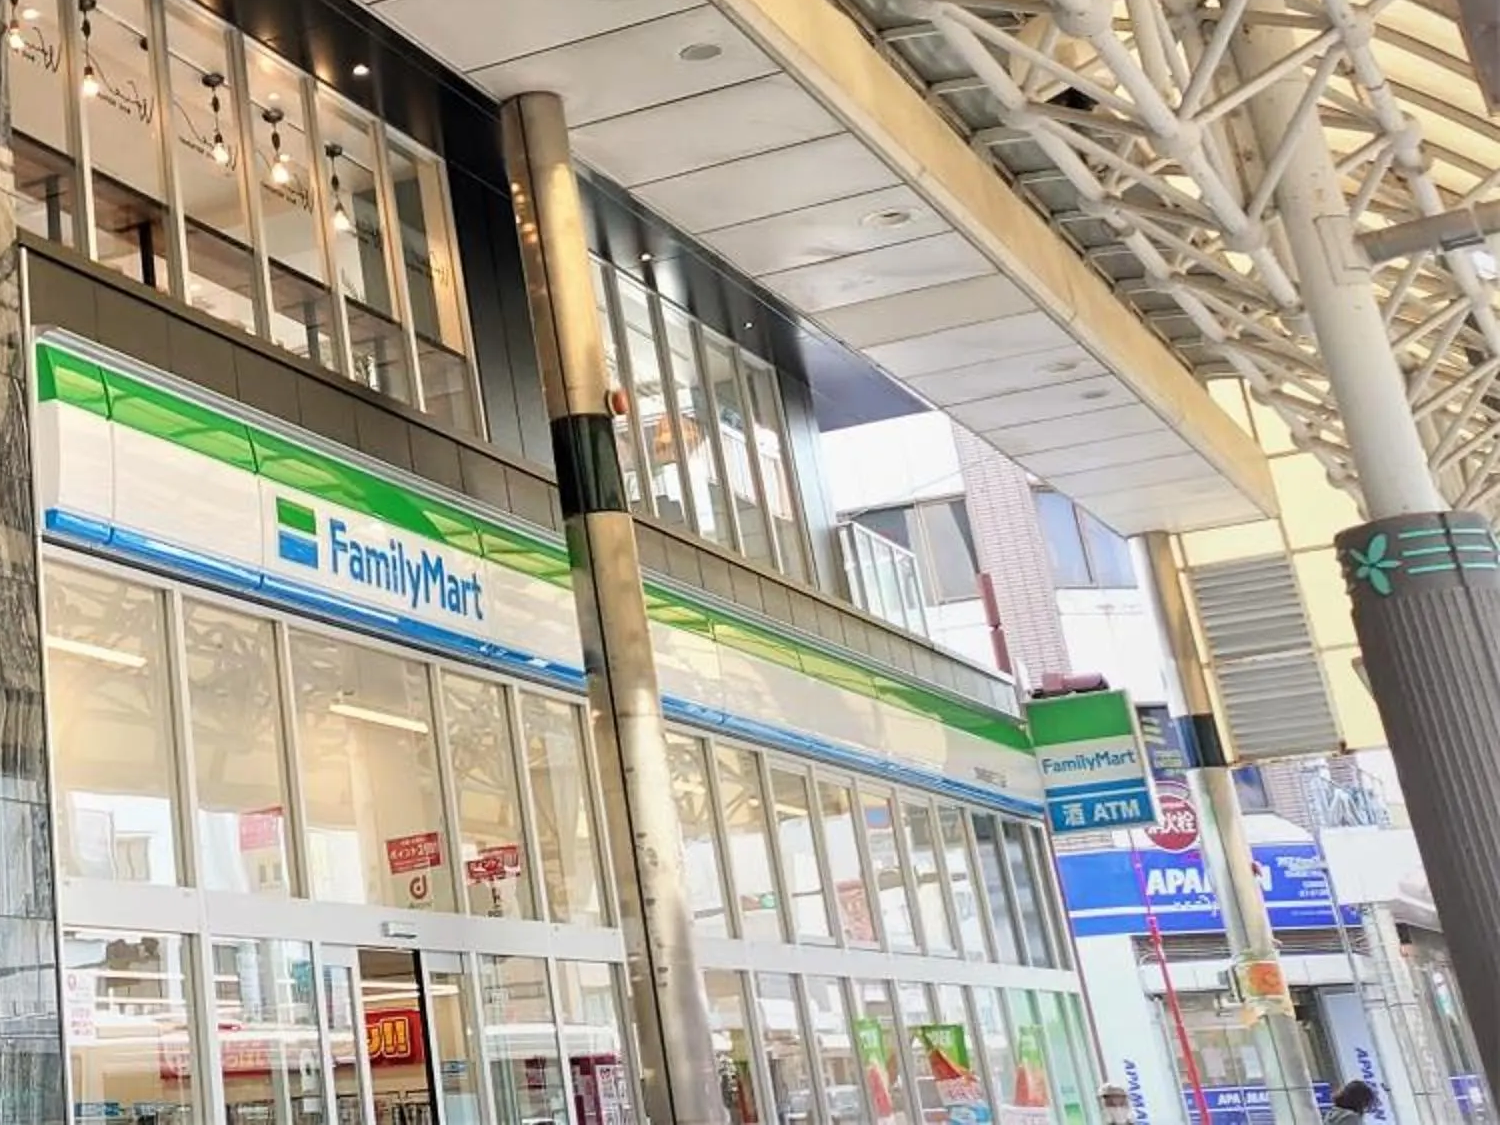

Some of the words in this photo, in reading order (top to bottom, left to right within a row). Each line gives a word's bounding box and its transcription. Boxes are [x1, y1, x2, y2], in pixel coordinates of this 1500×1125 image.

[329, 518, 483, 620] FamilyMart
[1042, 749, 1136, 773] FamilyMart
[1063, 802, 1085, 826] 酒
[1093, 799, 1141, 822] ATM
